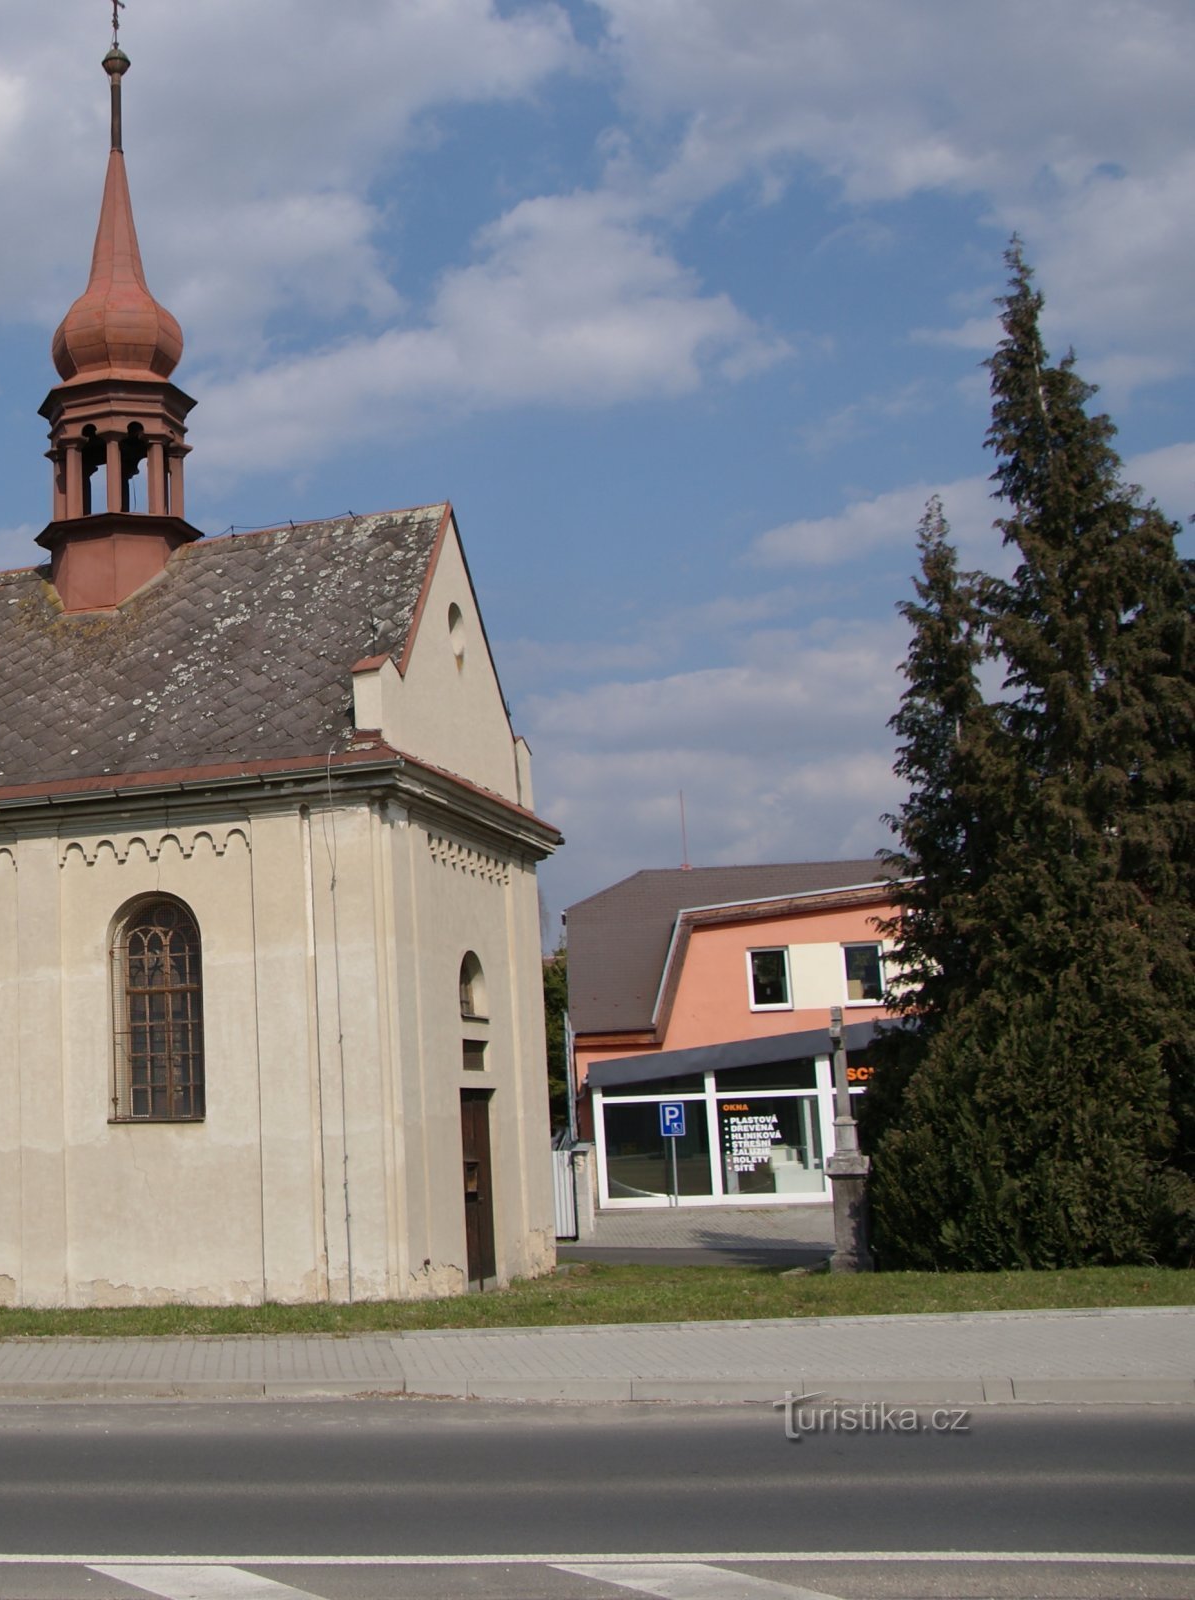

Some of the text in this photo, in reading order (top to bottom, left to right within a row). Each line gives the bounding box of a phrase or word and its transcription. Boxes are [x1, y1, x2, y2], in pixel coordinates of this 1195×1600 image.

[665, 1106, 680, 1126] P
[730, 1114, 778, 1124] PLASTOVÁ
[733, 1156, 769, 1164] ROLETY
